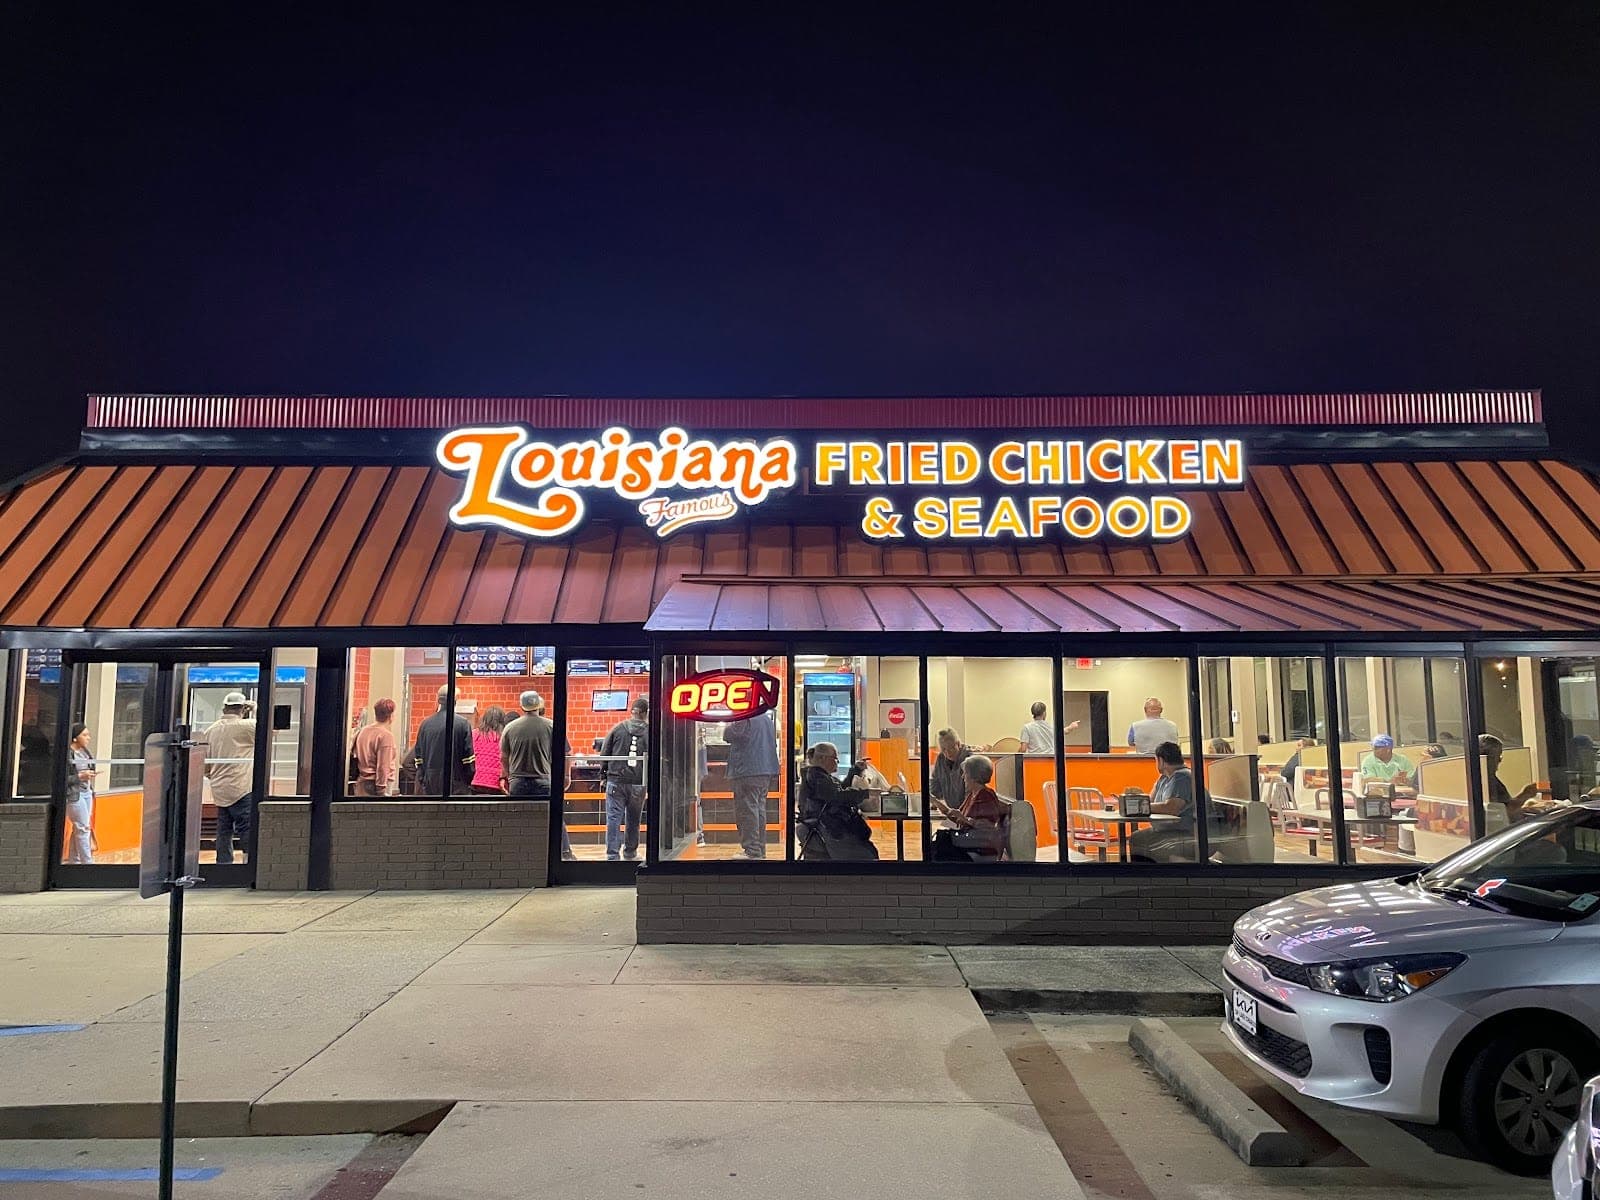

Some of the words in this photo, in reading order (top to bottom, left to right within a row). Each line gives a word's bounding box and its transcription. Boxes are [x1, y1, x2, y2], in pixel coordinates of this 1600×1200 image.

[441, 428, 794, 533] Louisiana
[816, 443, 981, 484] FRIED
[989, 440, 1242, 484] CHICKEN
[641, 493, 735, 528] Famous
[862, 498, 903, 537] &
[914, 497, 1191, 538] SEAFOOD
[670, 680, 779, 713] OPEN
